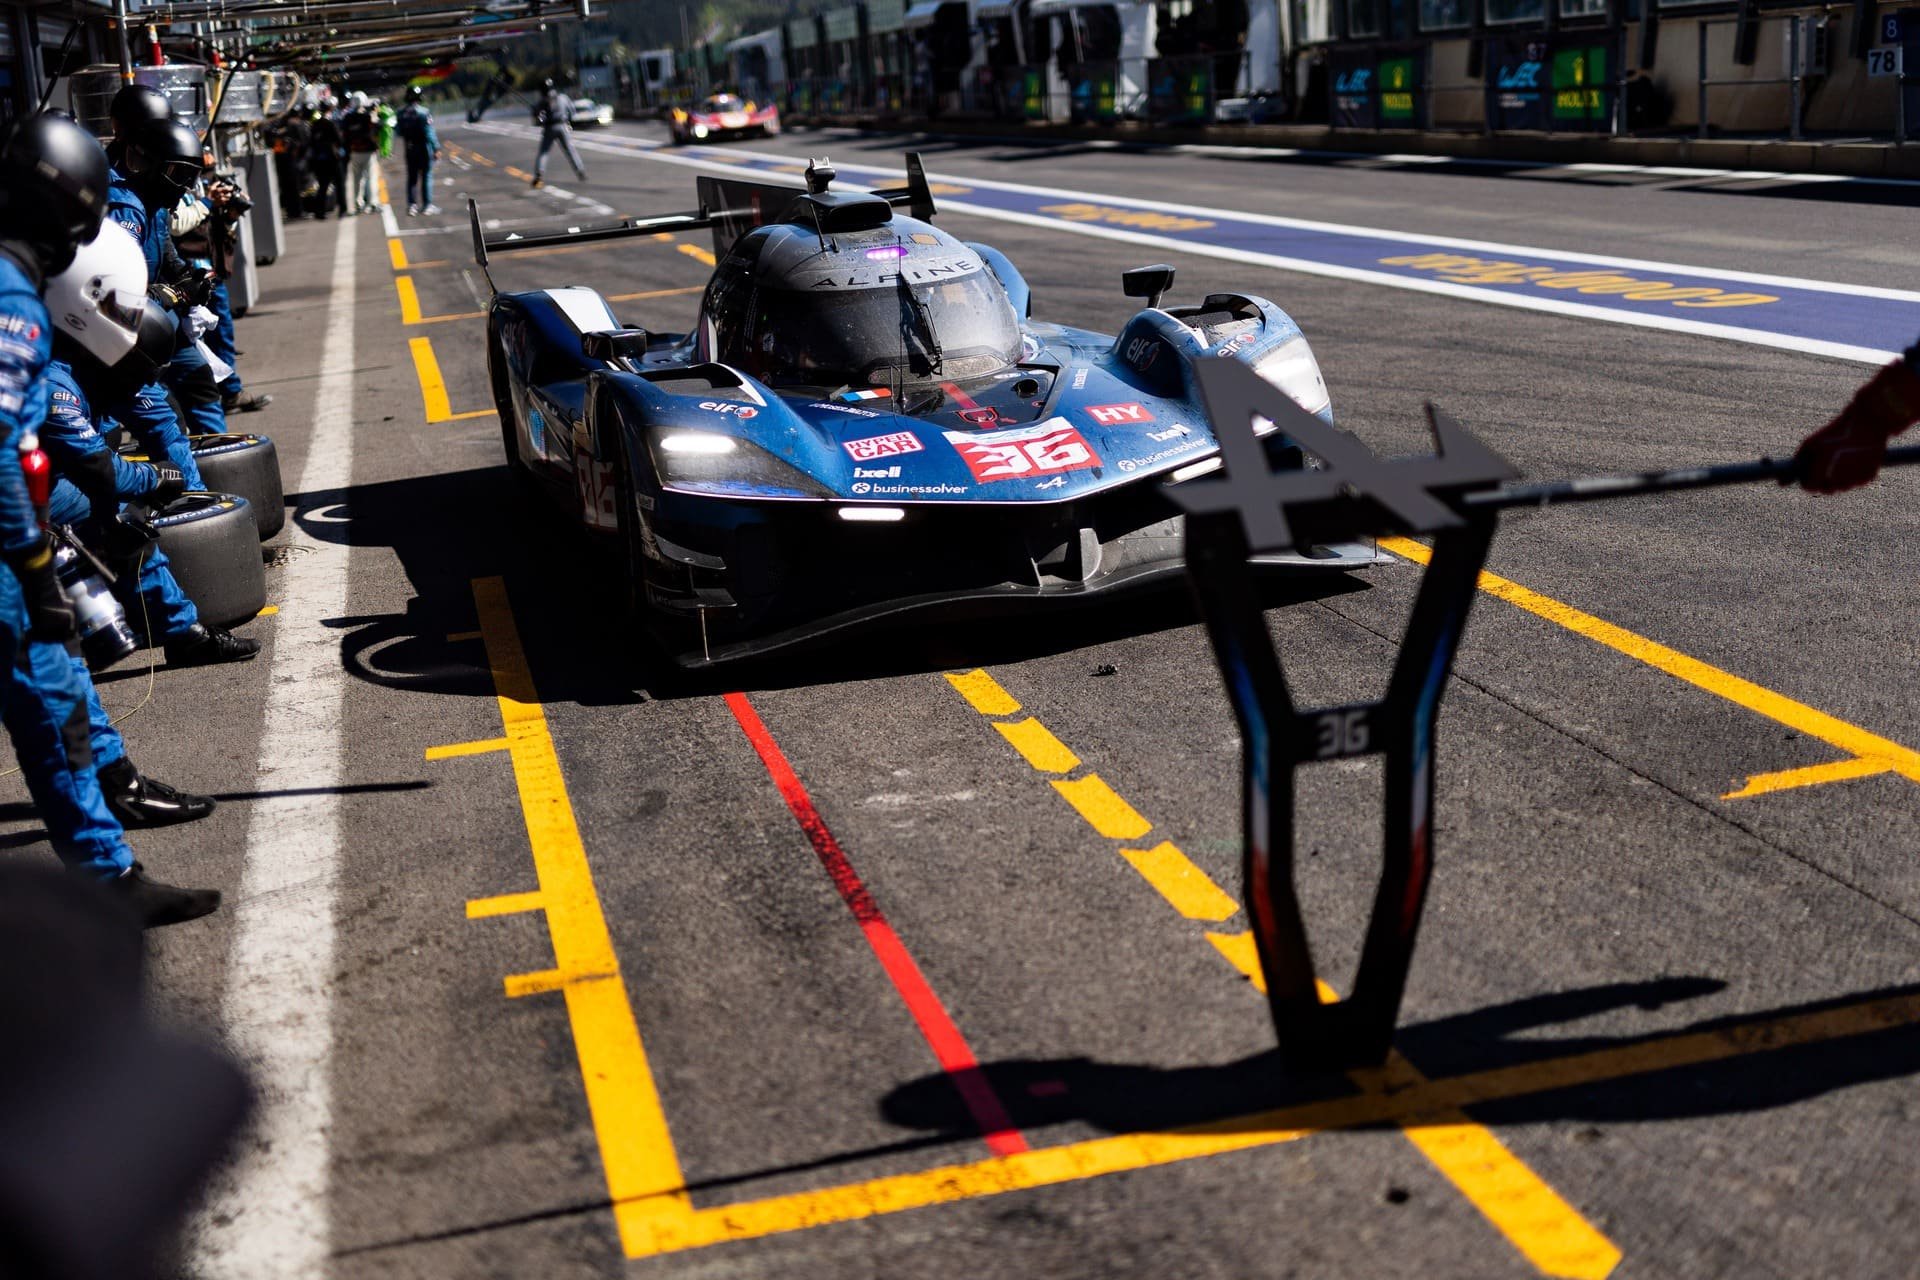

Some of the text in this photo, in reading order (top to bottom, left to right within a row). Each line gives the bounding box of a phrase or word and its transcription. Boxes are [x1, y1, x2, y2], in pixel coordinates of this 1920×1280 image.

[1870, 50, 1896, 74] 78
[811, 260, 974, 288] ALPINE
[699, 401, 737, 413] elf
[1091, 405, 1142, 422] HY
[848, 434, 909, 449] HYPER
[854, 439, 917, 458] CAR
[964, 432, 1091, 477] 36
[1132, 437, 1207, 466] businessolver
[853, 466, 902, 478] ixell
[873, 483, 968, 494] businessolver
[1317, 710, 1370, 757] 36
